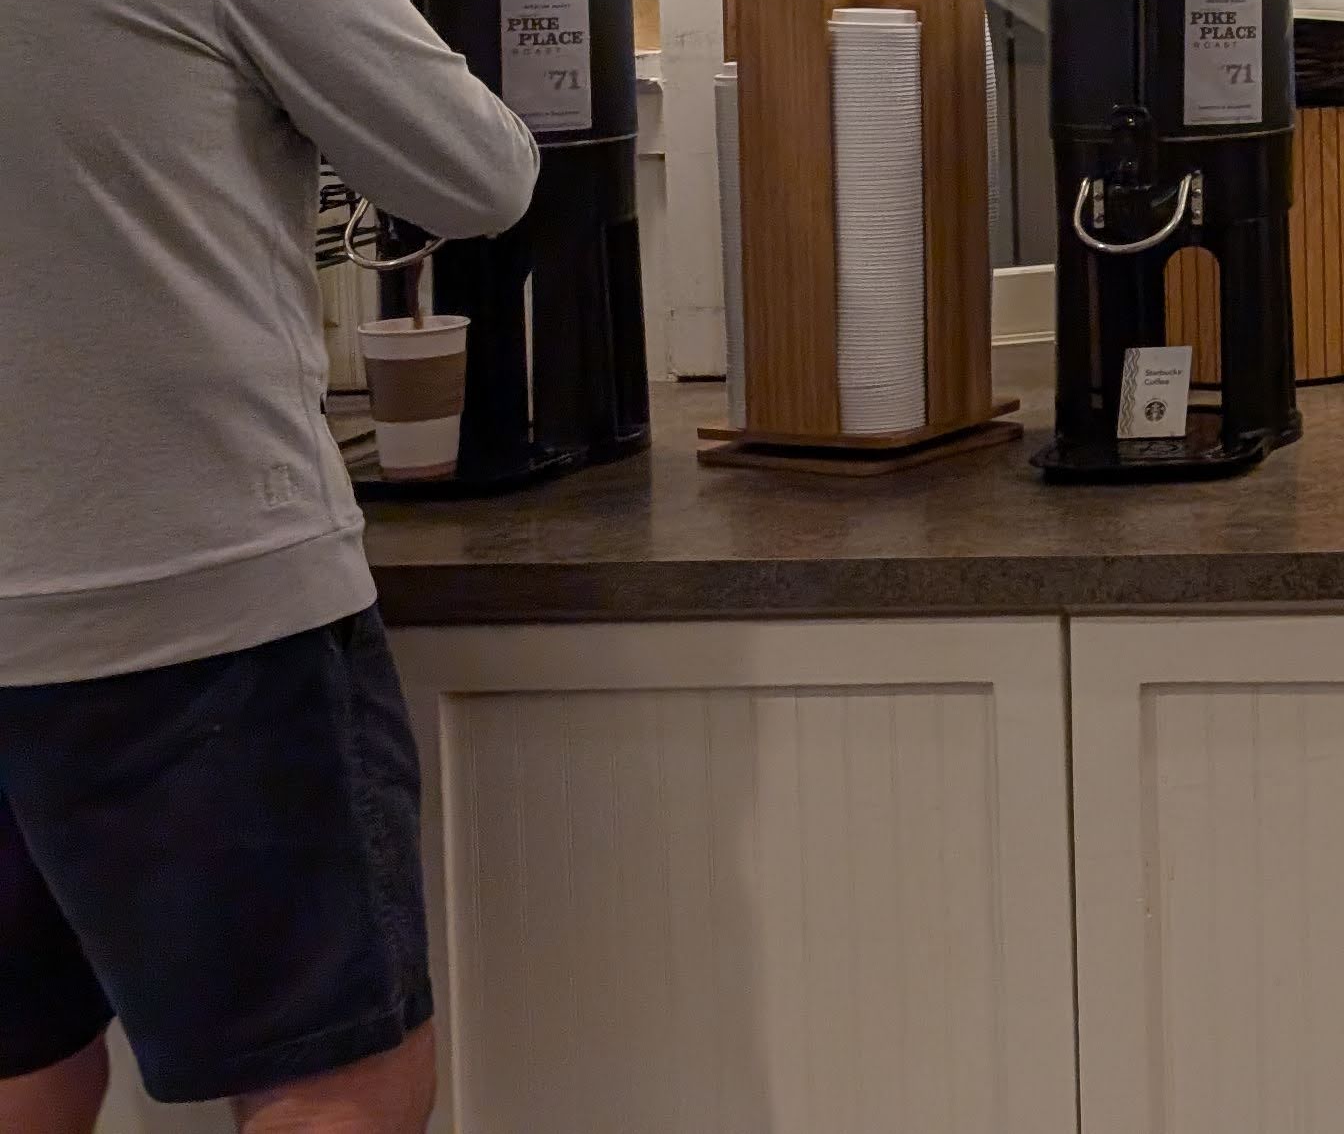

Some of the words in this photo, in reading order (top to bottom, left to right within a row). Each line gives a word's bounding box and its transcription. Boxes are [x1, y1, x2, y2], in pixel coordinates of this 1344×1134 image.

[507, 17, 560, 32] PIKE
[1190, 12, 1237, 25] PIKE
[517, 31, 583, 46] PLACE
[1199, 26, 1257, 40] PLACE
